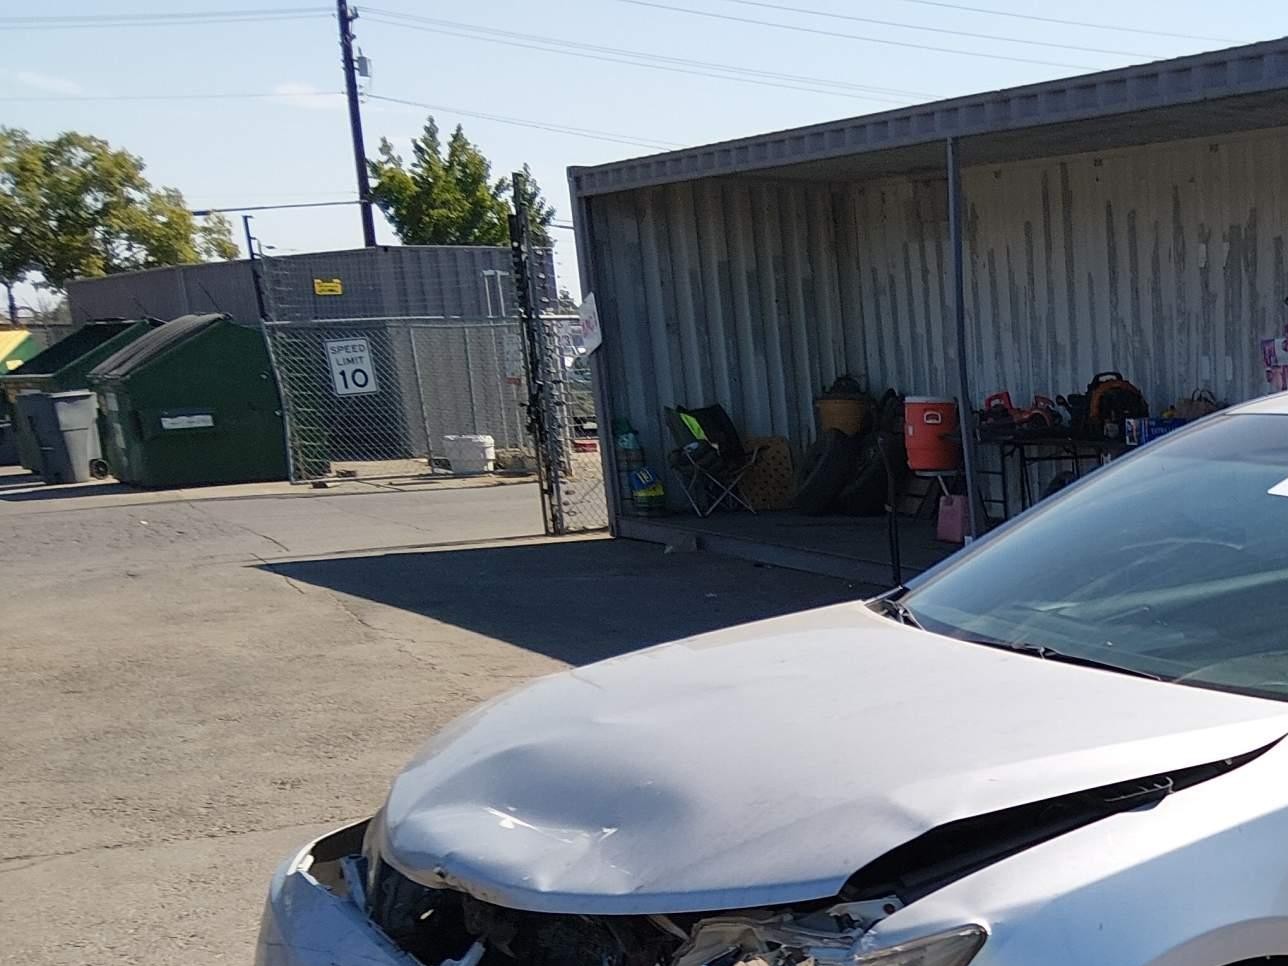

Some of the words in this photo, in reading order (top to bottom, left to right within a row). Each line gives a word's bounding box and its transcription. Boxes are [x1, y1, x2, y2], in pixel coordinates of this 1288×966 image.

[330, 344, 365, 354] SPEED
[337, 356, 364, 366] LIMIT
[339, 368, 369, 389] 10
